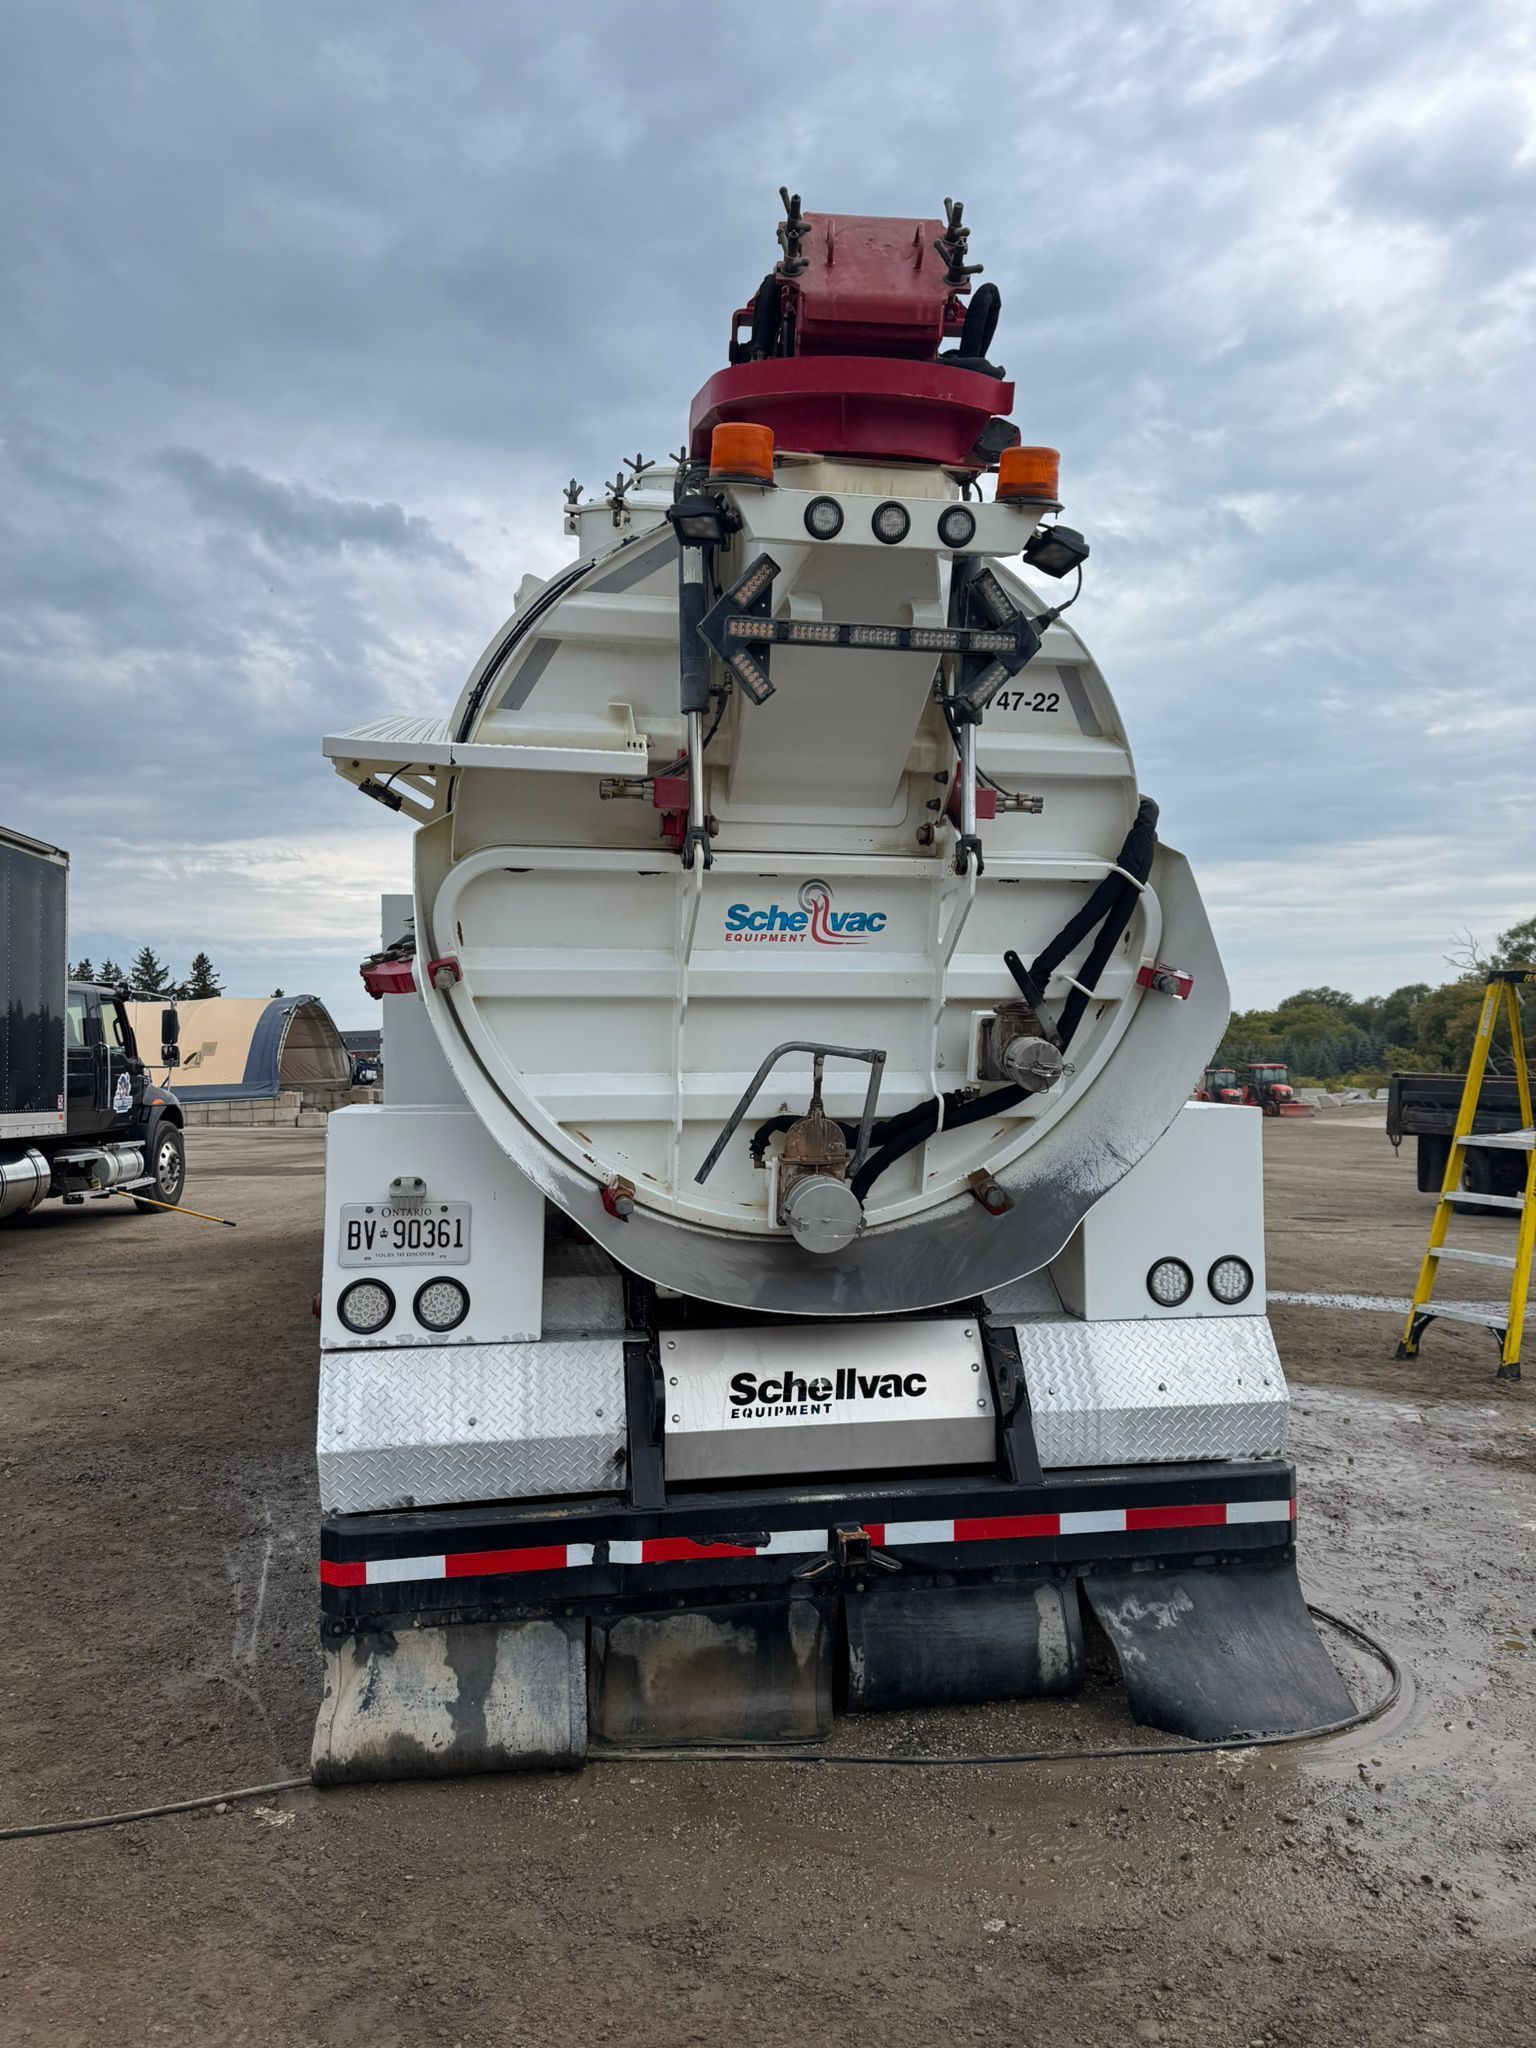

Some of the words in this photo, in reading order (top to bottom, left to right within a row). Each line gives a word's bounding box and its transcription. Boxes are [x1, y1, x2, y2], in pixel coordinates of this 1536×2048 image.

[724, 933, 807, 943] EQUIPMENT
[381, 1207, 432, 1218] ONTARIO
[347, 1220, 377, 1250] BV
[392, 1218, 464, 1250] 90361
[728, 1367, 927, 1406] Schellvac
[730, 1403, 833, 1419] EQUIPMENT
